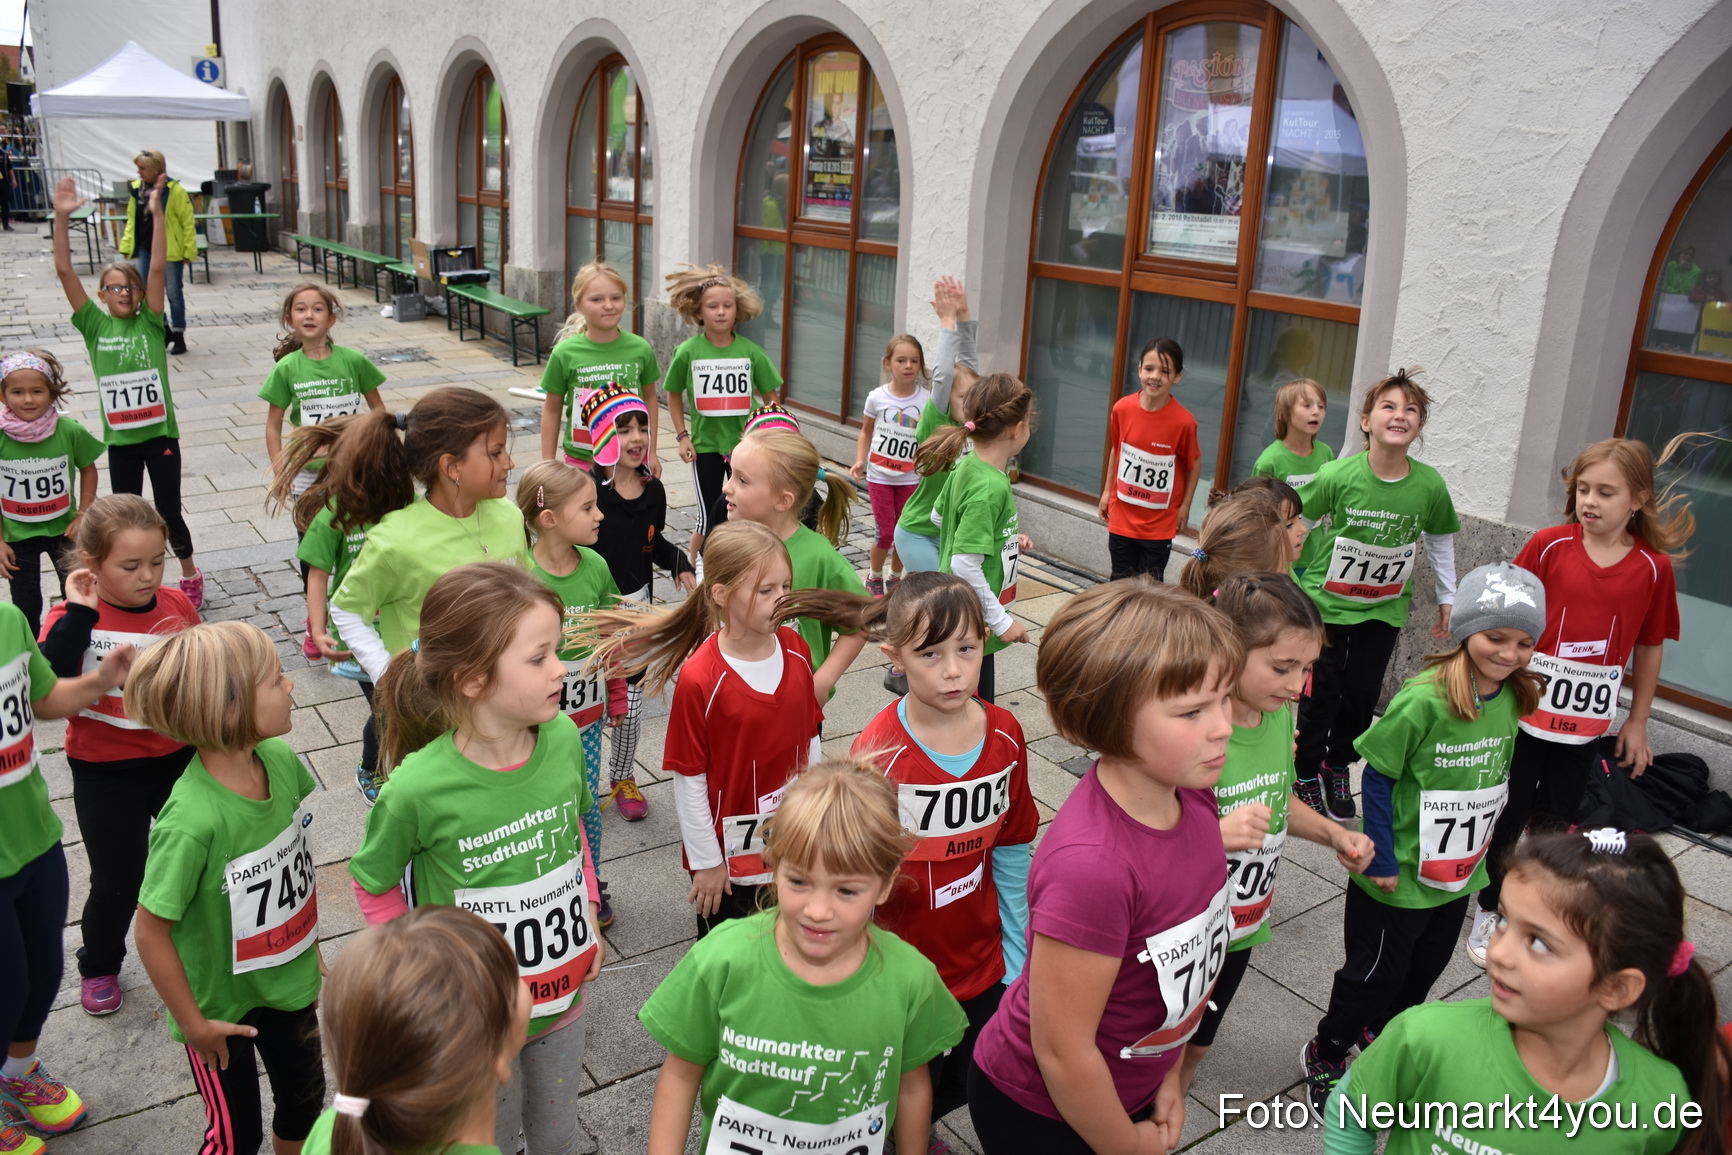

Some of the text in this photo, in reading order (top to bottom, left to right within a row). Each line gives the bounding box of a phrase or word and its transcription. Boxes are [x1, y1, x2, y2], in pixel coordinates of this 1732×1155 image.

[1083, 116, 1108, 125] KulTour
[1283, 117, 1318, 128] KulTour
[1082, 126, 1104, 134] NACHT
[1282, 128, 1342, 139] NACHT 2015
[576, 363, 622, 374] Neumarkter
[120, 378, 150, 386] Neumarkt
[294, 378, 338, 390] Neumarkter
[577, 372, 614, 383] Stadtlauf
[699, 373, 747, 394] 7406
[107, 384, 158, 409] 7176
[296, 387, 330, 398] Stadtlauf
[120, 410, 152, 422] Johanna
[886, 460, 902, 470] Lara
[1138, 456, 1166, 467] Neumarkt
[22, 466, 58, 475] Neumarkt
[1123, 459, 1168, 489] 7138
[4, 472, 64, 499] 7195
[1127, 487, 1151, 500] Sarah
[16, 504, 56, 514] Josefine
[1346, 508, 1400, 520] Neumarkter
[1346, 518, 1386, 531] Stadtlauf
[1336, 545, 1402, 560] PARTL Neumarkt
[1338, 556, 1406, 584] 7147
[1350, 587, 1379, 596] Paula
[1572, 645, 1594, 653] DEHN
[1533, 658, 1607, 679] PARTL Neumarkt
[0, 683, 32, 743] 36
[1550, 717, 1576, 732] Lisa
[1436, 736, 1502, 754] Neumarkter
[1434, 752, 1491, 768] Stadtlauf
[915, 774, 1007, 830] 7003
[1424, 801, 1464, 811] PARTL
[458, 805, 558, 853] Neumarkter
[1434, 802, 1504, 854] 717
[462, 829, 544, 873] Stadtlauf
[946, 837, 983, 857] Anna
[231, 858, 276, 884] PARTL
[951, 878, 974, 896] DEHN
[461, 879, 576, 914] PARTL Neumarkt
[1158, 935, 1202, 967] PARTL
[1174, 924, 1230, 1020] 715
[530, 974, 570, 1000] Maya
[722, 1025, 845, 1062] Neumarkter
[720, 1048, 817, 1086] Stadtlauf
[718, 1115, 777, 1144] PARTL
[783, 1128, 862, 1149] Neumarkt
